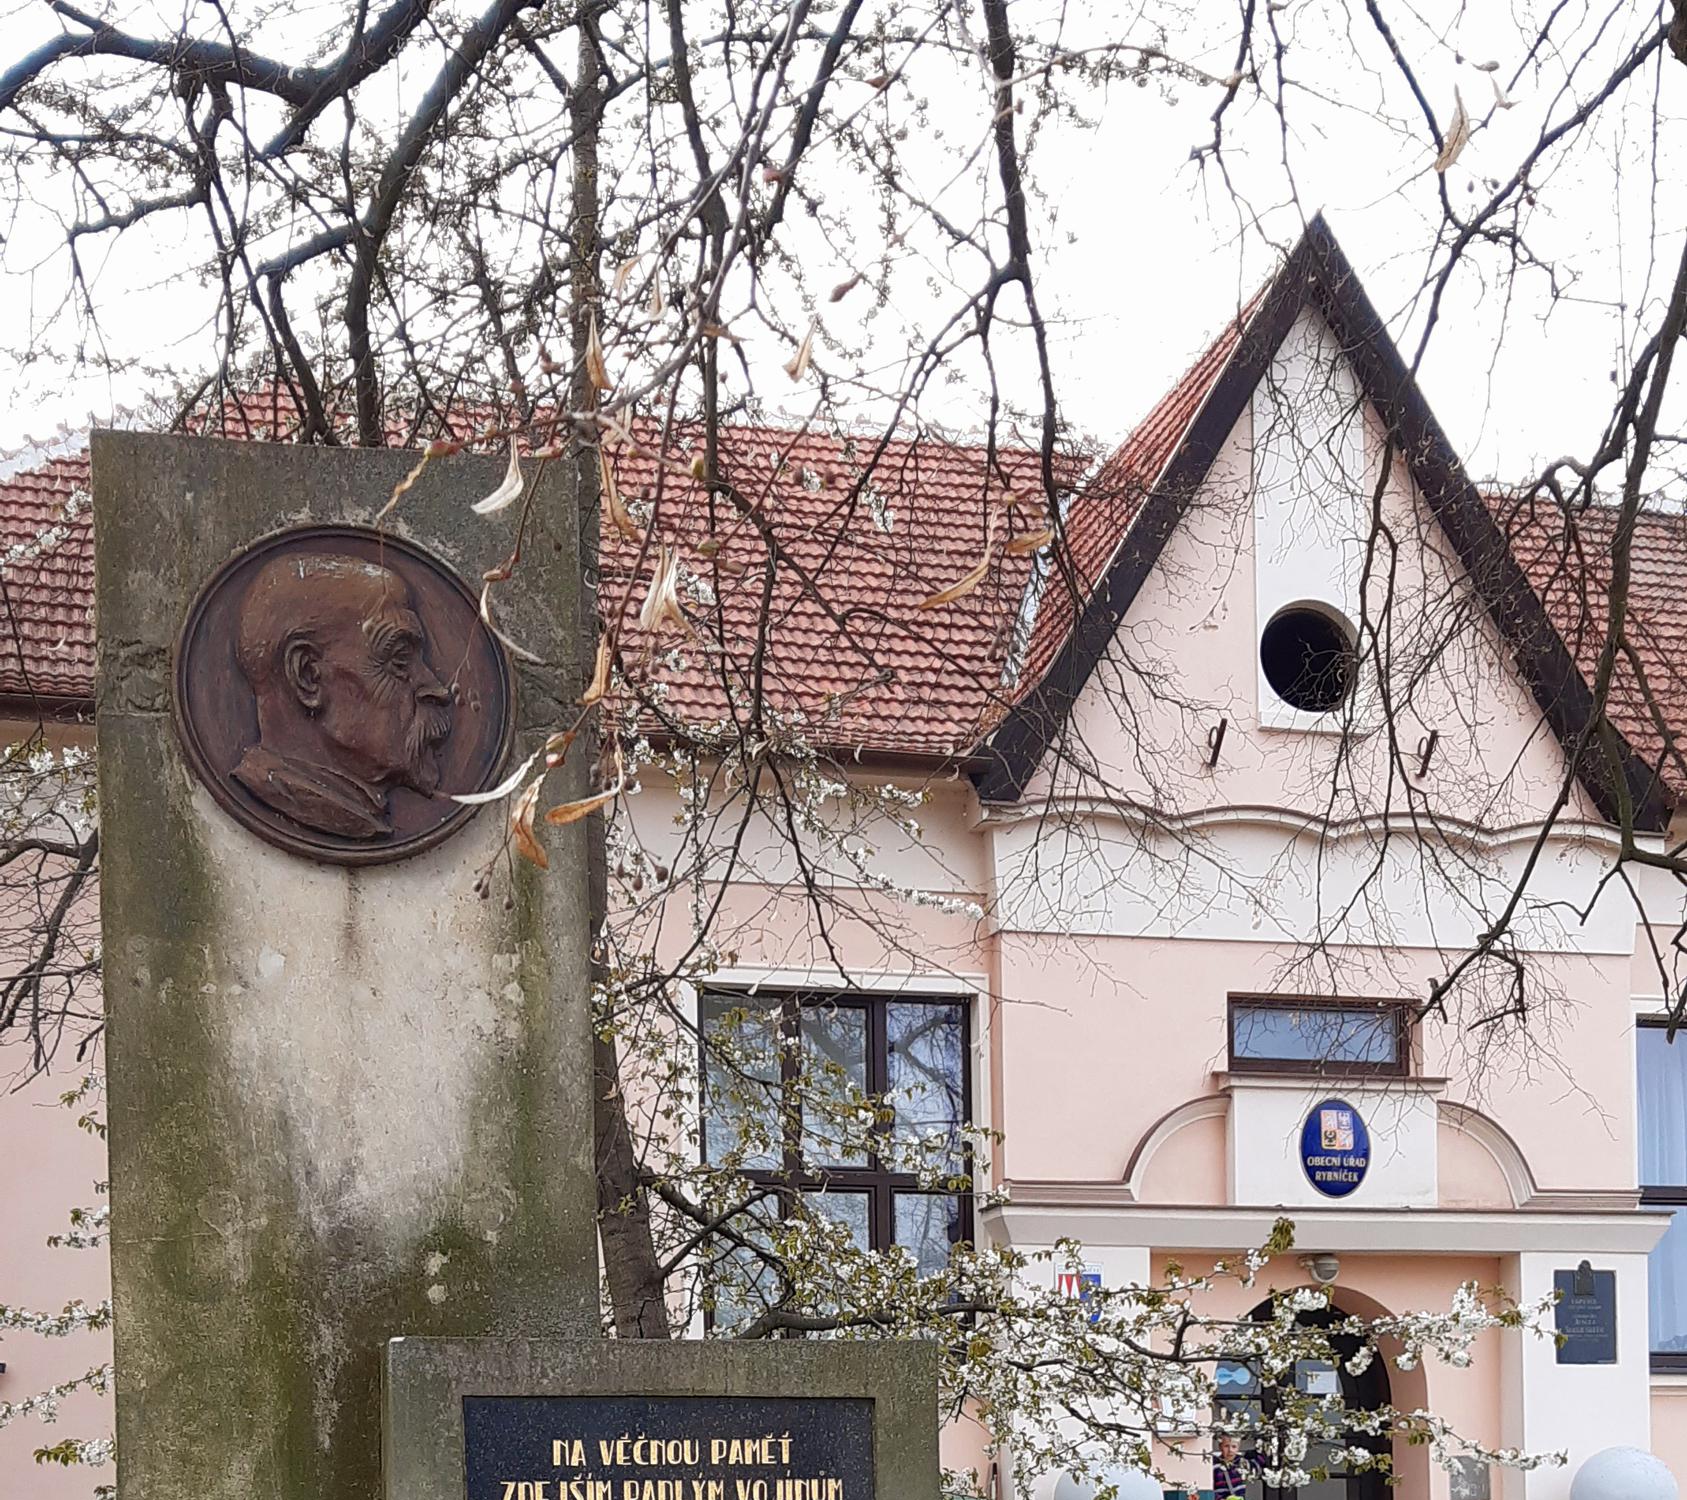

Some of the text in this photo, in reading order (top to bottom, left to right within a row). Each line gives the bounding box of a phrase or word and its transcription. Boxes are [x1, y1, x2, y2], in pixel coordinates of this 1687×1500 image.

[1306, 1154, 1366, 1168] OBECNÍ ÚŘAD
[1315, 1168, 1359, 1182] RYBNÍČEK
[552, 1431, 793, 1467] NA VĚČNOU PAMĚŤ
